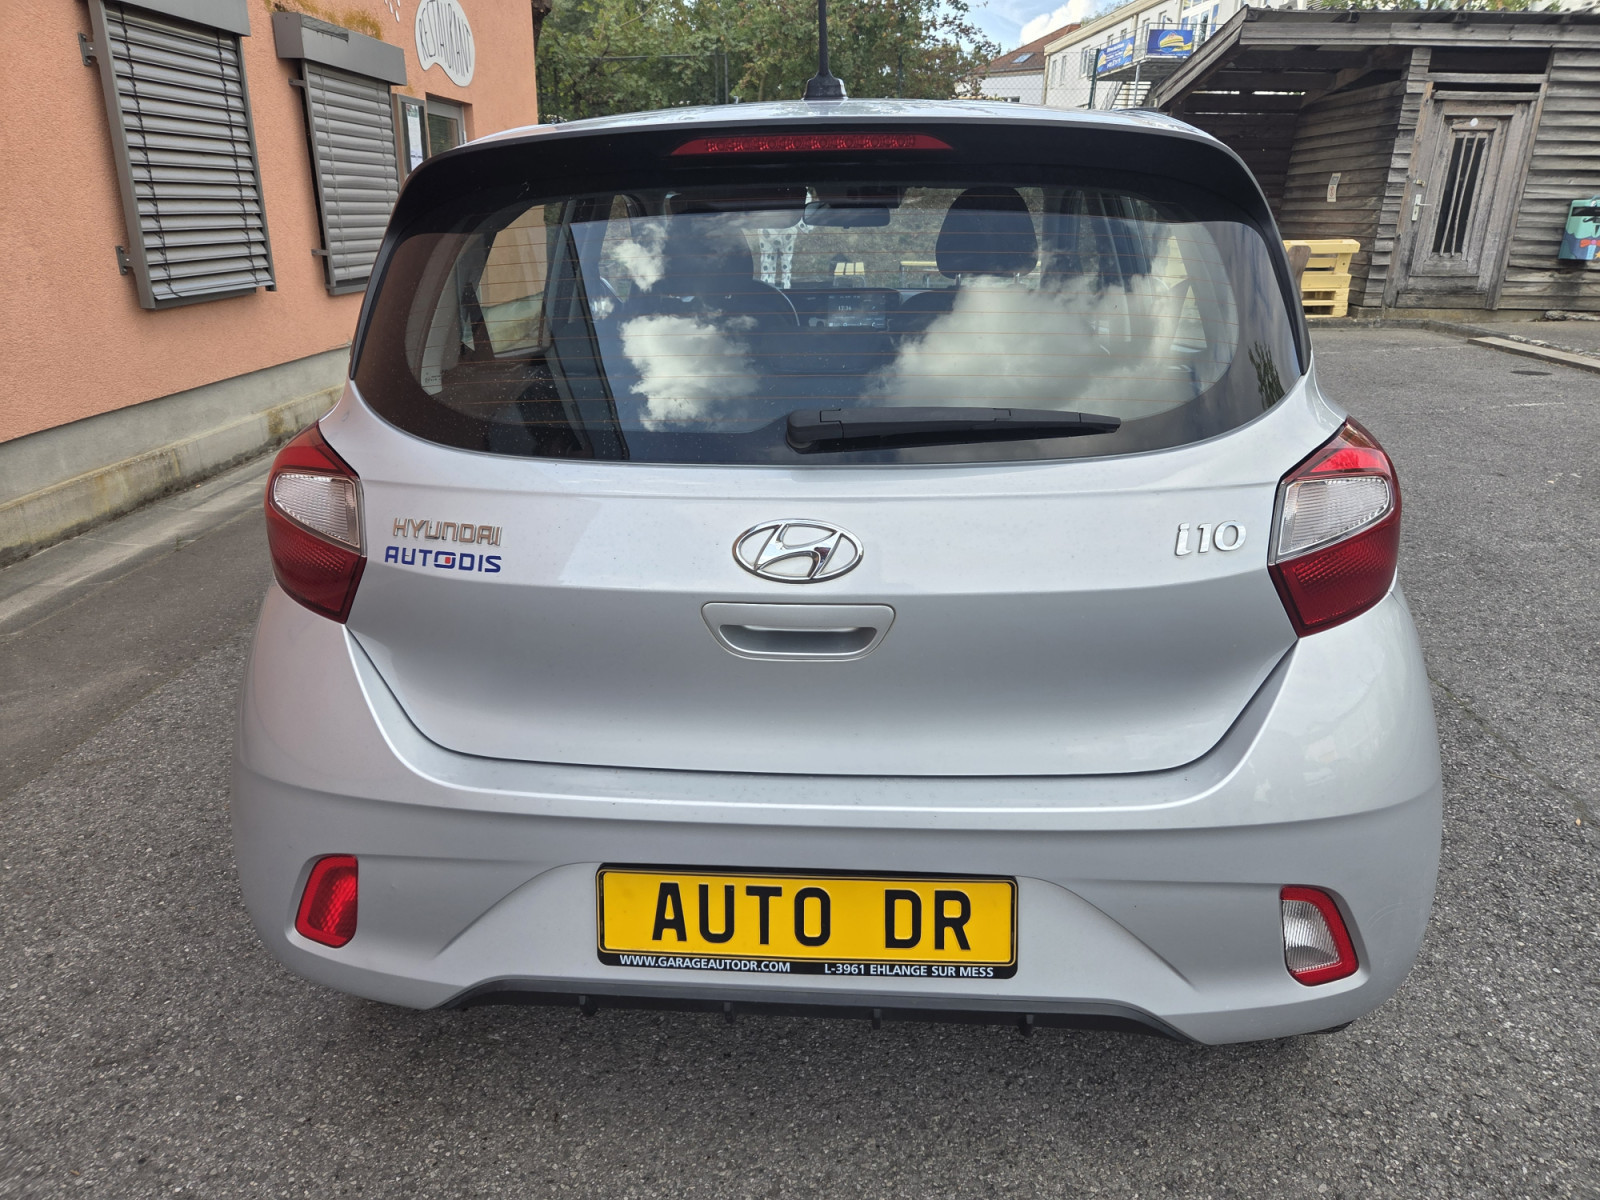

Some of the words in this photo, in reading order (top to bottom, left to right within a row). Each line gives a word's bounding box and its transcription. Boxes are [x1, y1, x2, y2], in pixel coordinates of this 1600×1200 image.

[393, 517, 502, 546] HYUNDAI
[1174, 520, 1247, 556] i10
[384, 545, 502, 573] AUTODIS
[652, 882, 831, 947] AUTO
[884, 889, 971, 951] DR
[619, 954, 791, 973] WWW.GARAGEAUTODR.COM
[824, 963, 865, 975] L-3961
[870, 964, 928, 976] EHLANGE
[931, 966, 956, 977] SUR
[959, 967, 994, 978] MESS
